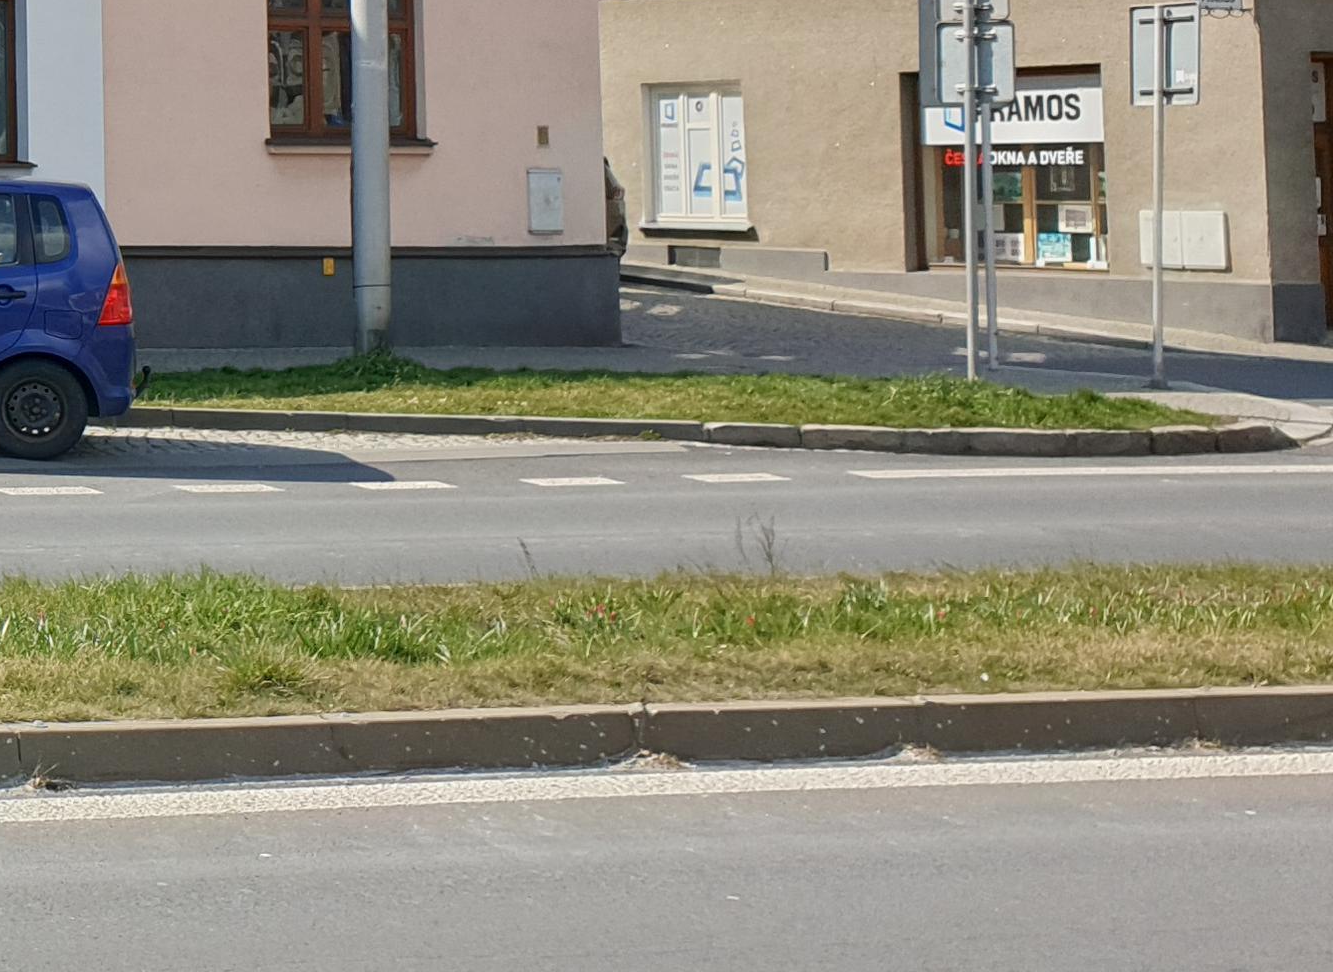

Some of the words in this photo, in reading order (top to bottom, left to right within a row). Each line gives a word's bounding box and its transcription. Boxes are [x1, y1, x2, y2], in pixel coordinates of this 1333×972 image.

[990, 150, 1026, 166] OKNA
[1027, 150, 1038, 166] A
[1039, 146, 1085, 166] DVEŘE
